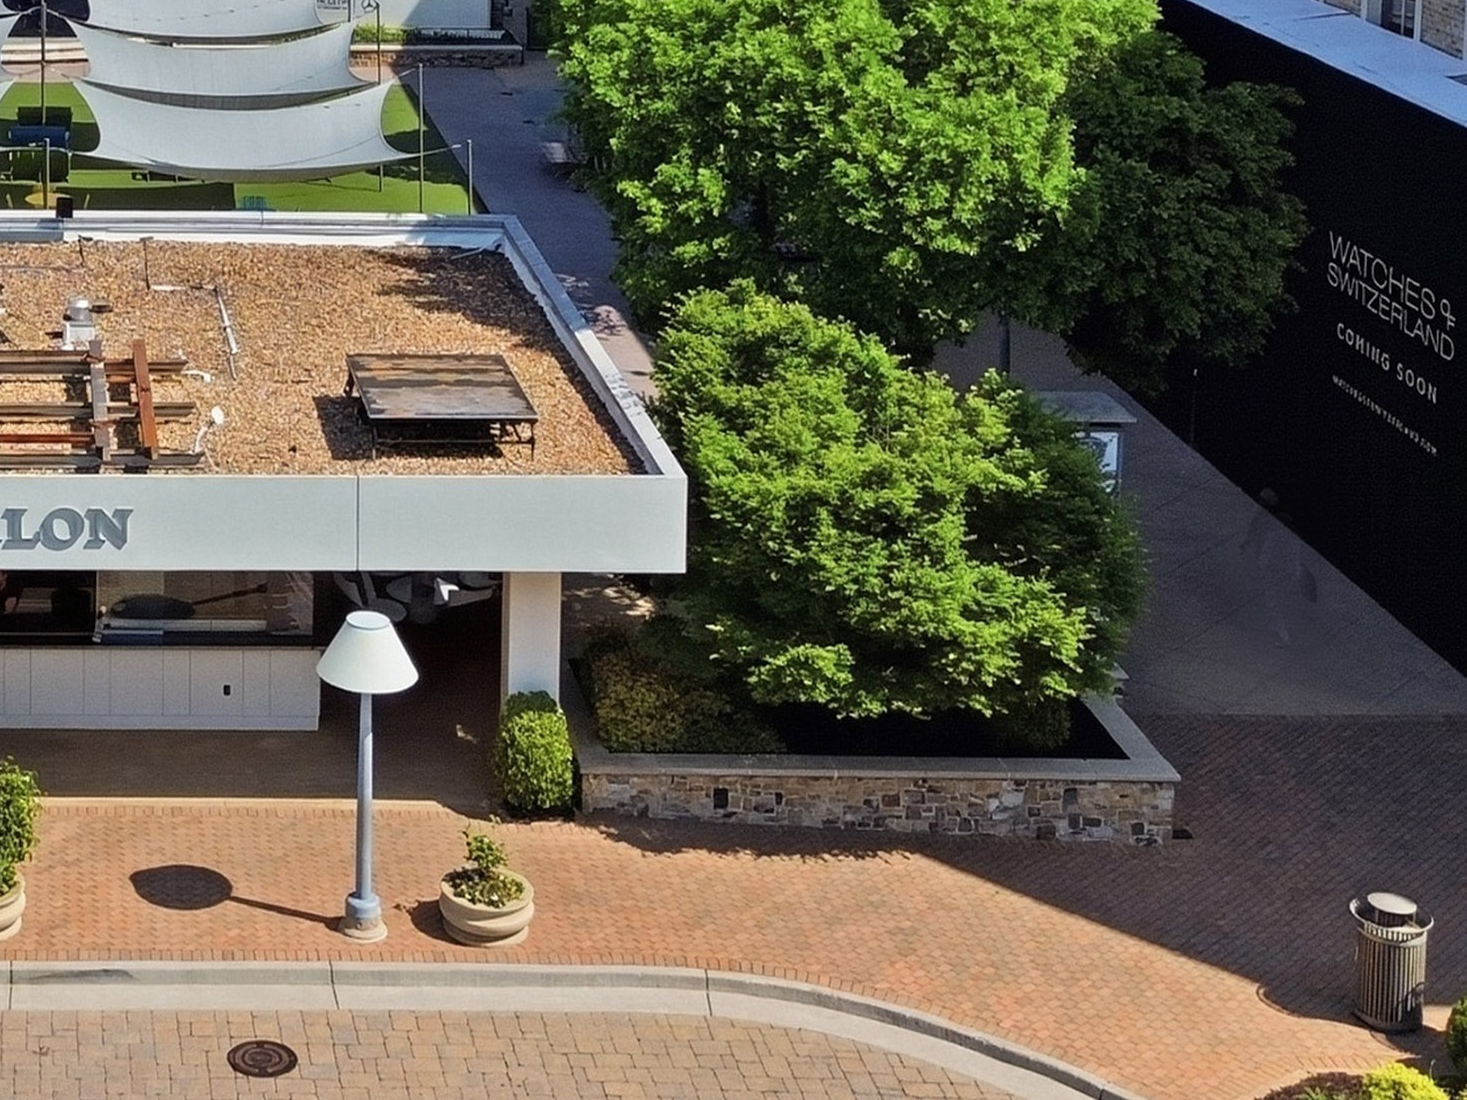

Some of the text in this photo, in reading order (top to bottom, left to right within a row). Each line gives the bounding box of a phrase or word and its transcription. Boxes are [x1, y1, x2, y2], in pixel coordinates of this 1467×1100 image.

[1326, 261, 1455, 361] SWITZERLAND
[1329, 229, 1436, 320] WATCHES
[1336, 322, 1438, 405] COMING SOON
